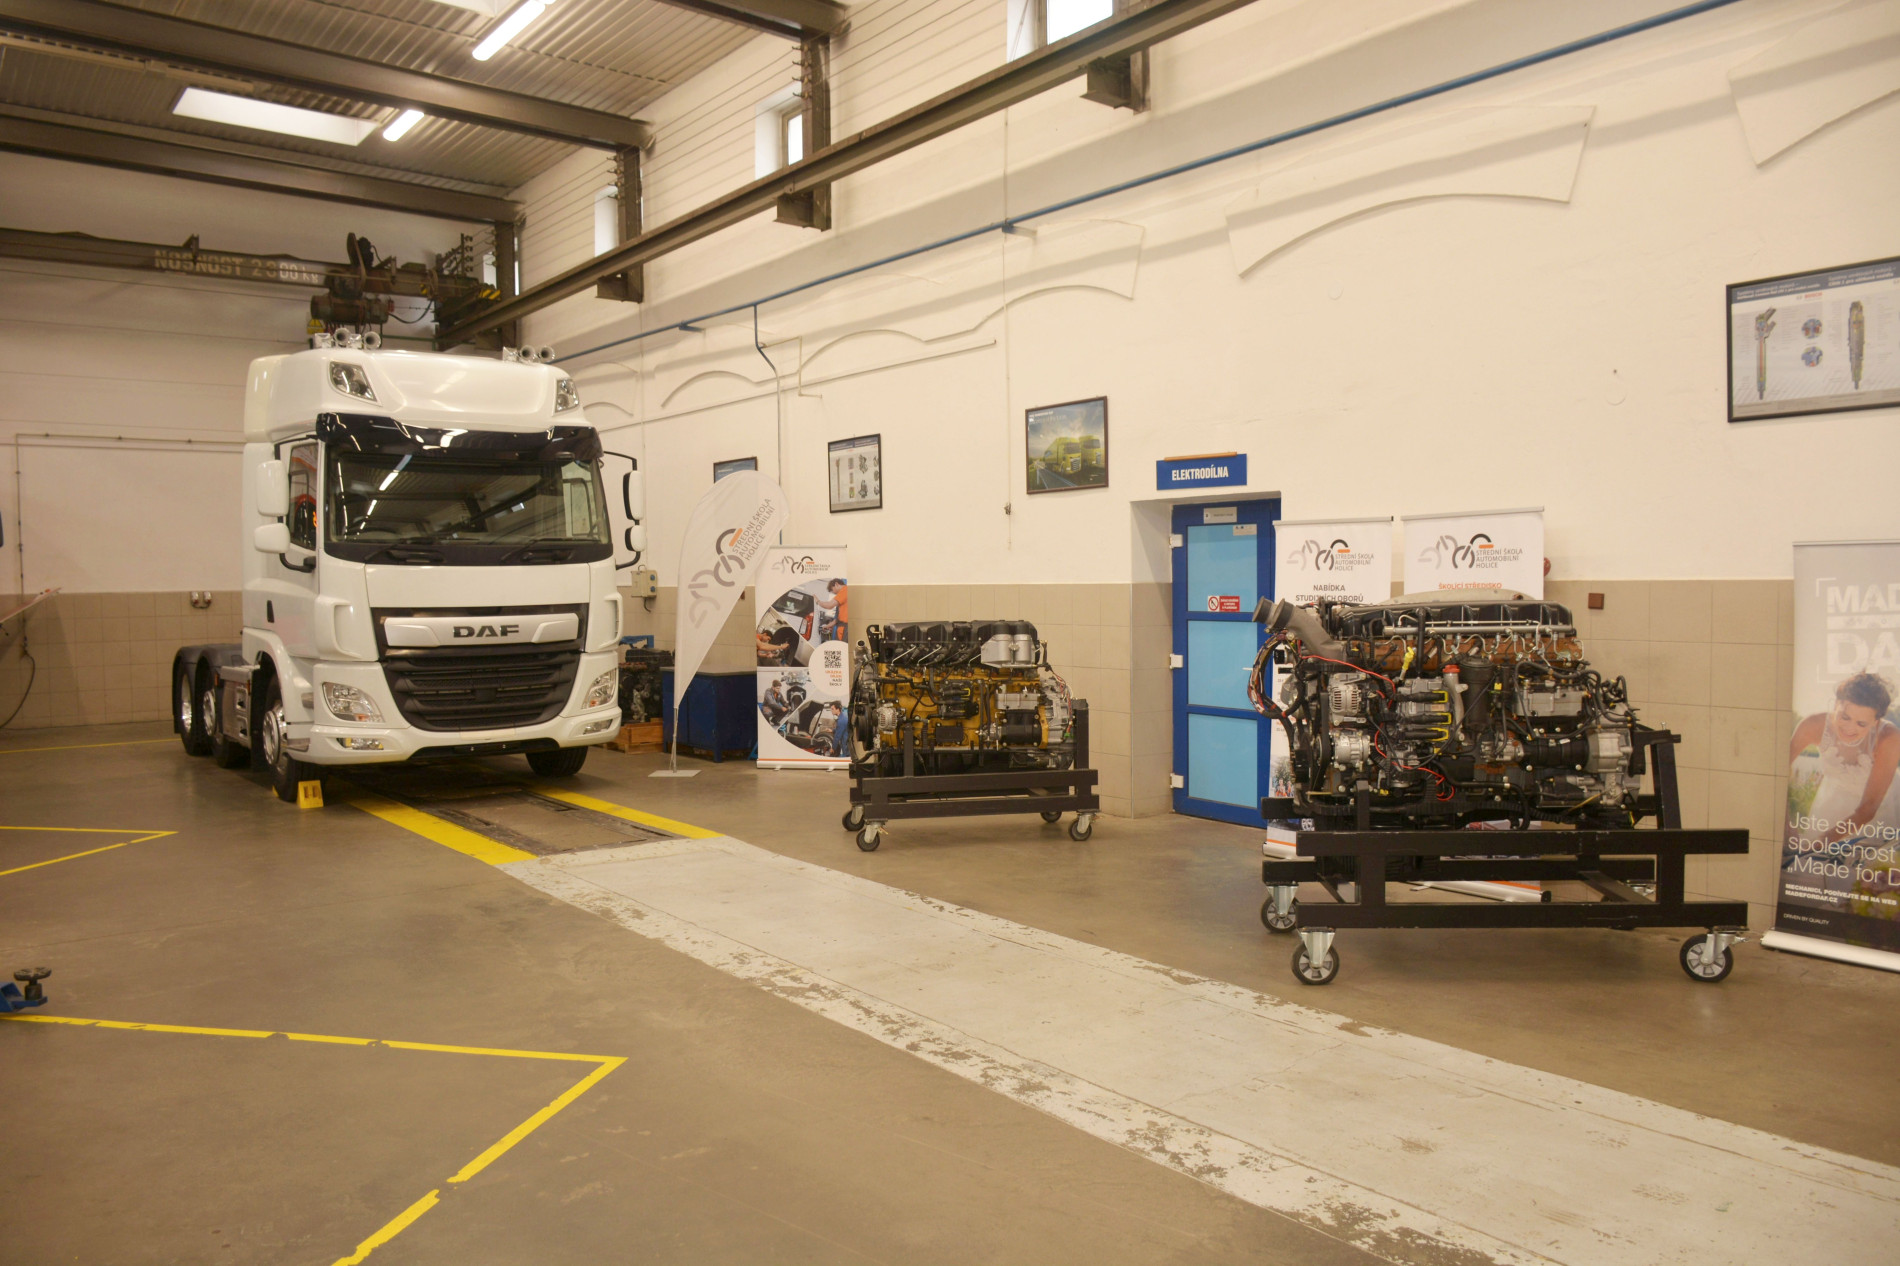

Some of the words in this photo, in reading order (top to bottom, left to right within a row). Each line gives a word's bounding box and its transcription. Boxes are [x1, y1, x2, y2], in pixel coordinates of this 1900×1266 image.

[155, 249, 243, 275] NOSNOST
[1172, 464, 1229, 481] ELEKTRODÍLNA
[752, 498, 771, 522] ŠKOLA
[739, 506, 776, 557] AUTOMOBILNÍ
[744, 533, 766, 561] HOLICE
[1503, 547, 1523, 555] ŠKOLA
[1313, 583, 1346, 592] NABÍDKA
[1465, 581, 1502, 589] STŘEDISKO
[1337, 593, 1364, 602] OBORŮ
[453, 624, 519, 638] DAF
[1789, 811, 1829, 833] Jste
[1788, 836, 1896, 863] společnost
[1855, 863, 1882, 883] for
[1785, 883, 1822, 894] MECHANICI,
[1823, 889, 1859, 900] PODÍVEJTE
[1881, 898, 1897, 906] WEB
[1783, 913, 1800, 921] DRIVEN
[1809, 917, 1829, 925] QUALITY
